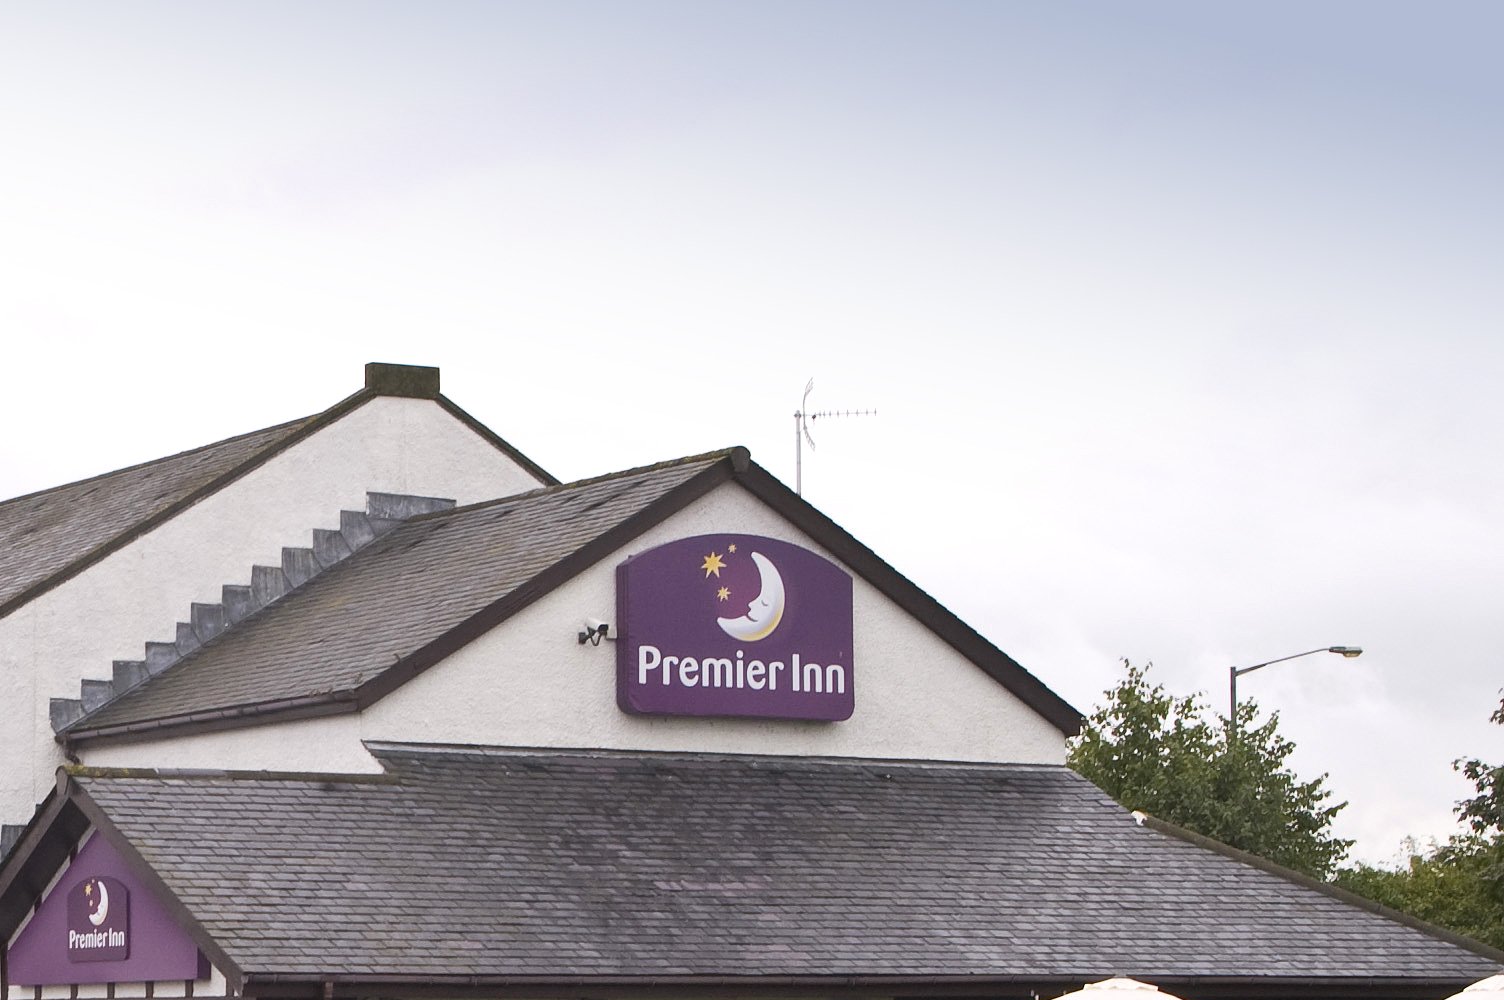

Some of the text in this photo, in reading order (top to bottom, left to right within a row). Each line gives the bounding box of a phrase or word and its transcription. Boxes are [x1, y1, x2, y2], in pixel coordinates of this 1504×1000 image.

[638, 645, 845, 694] Premier Inn
[69, 927, 125, 949] Premier Inn
